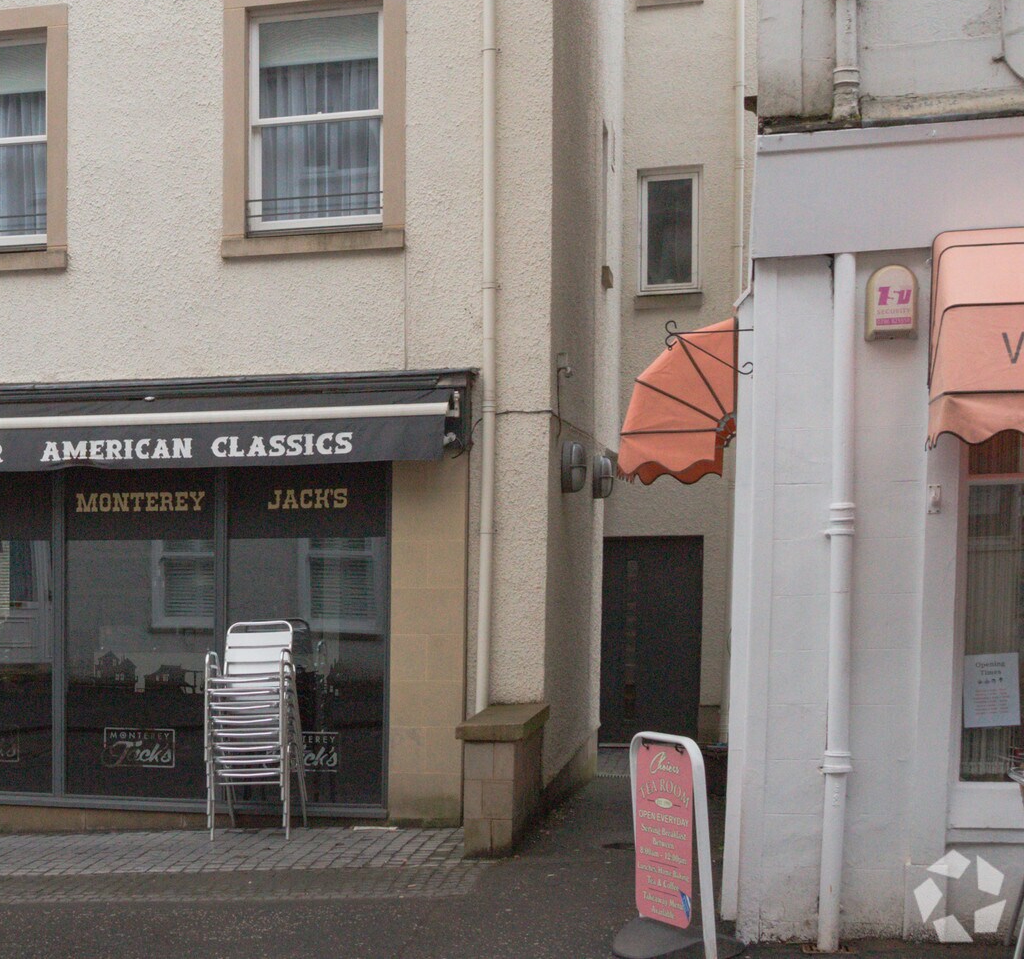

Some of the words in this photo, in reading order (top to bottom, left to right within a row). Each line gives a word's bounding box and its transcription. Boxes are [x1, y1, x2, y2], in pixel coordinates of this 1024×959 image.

[877, 307, 910, 315] SECURITY
[40, 437, 193, 462] AMERICAN
[211, 431, 353, 458] CLASSICS
[76, 491, 205, 513] MONTEREY
[267, 487, 348, 510] JACK'S
[975, 661, 1006, 669] Opening
[109, 730, 171, 740] MONTEREY
[639, 781, 658, 798] TEA
[659, 778, 690, 808] ROOM
[638, 809, 656, 820] OPEN
[656, 813, 689, 827] EVERYDAY
[640, 823, 661, 836] Serving
